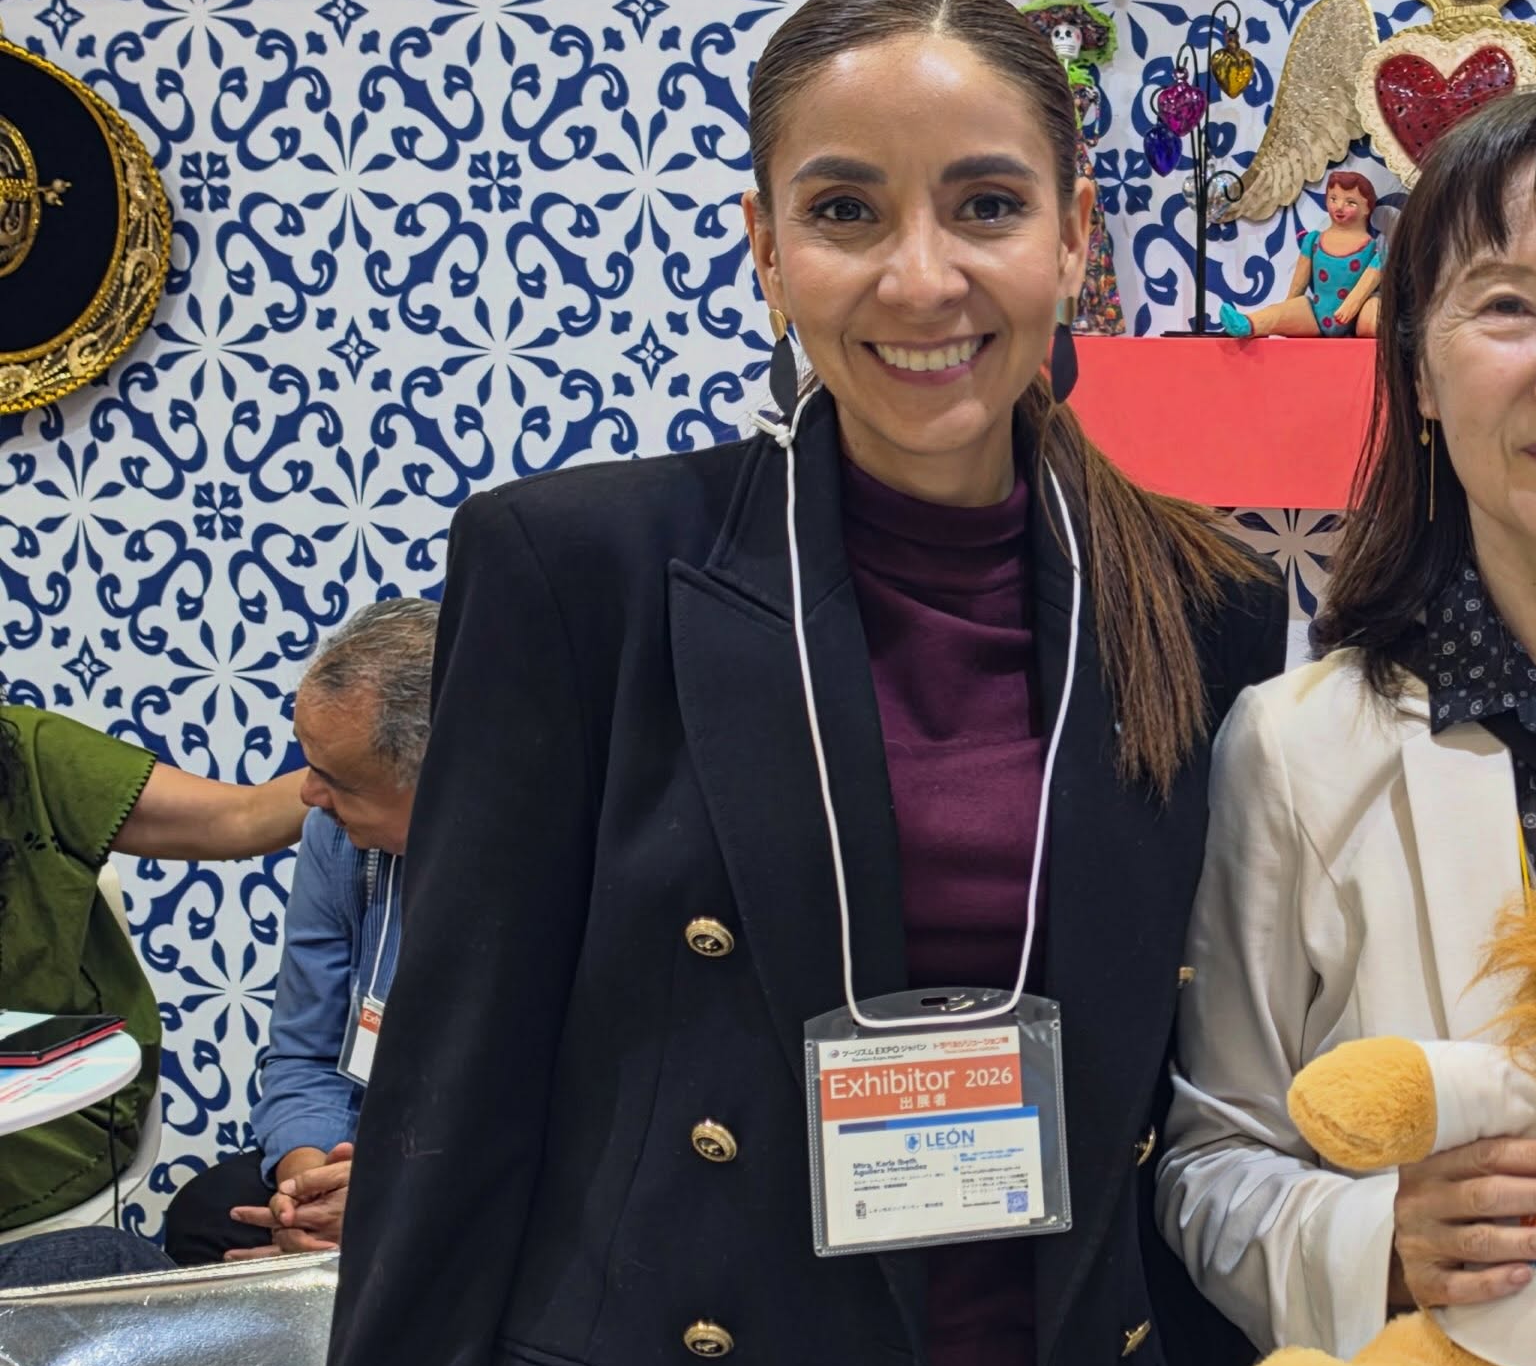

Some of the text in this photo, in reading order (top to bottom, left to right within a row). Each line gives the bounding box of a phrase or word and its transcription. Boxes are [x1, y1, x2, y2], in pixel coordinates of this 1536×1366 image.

[830, 1066, 1013, 1100] Exhibitor 2026
[926, 1128, 976, 1148] LEÓN
